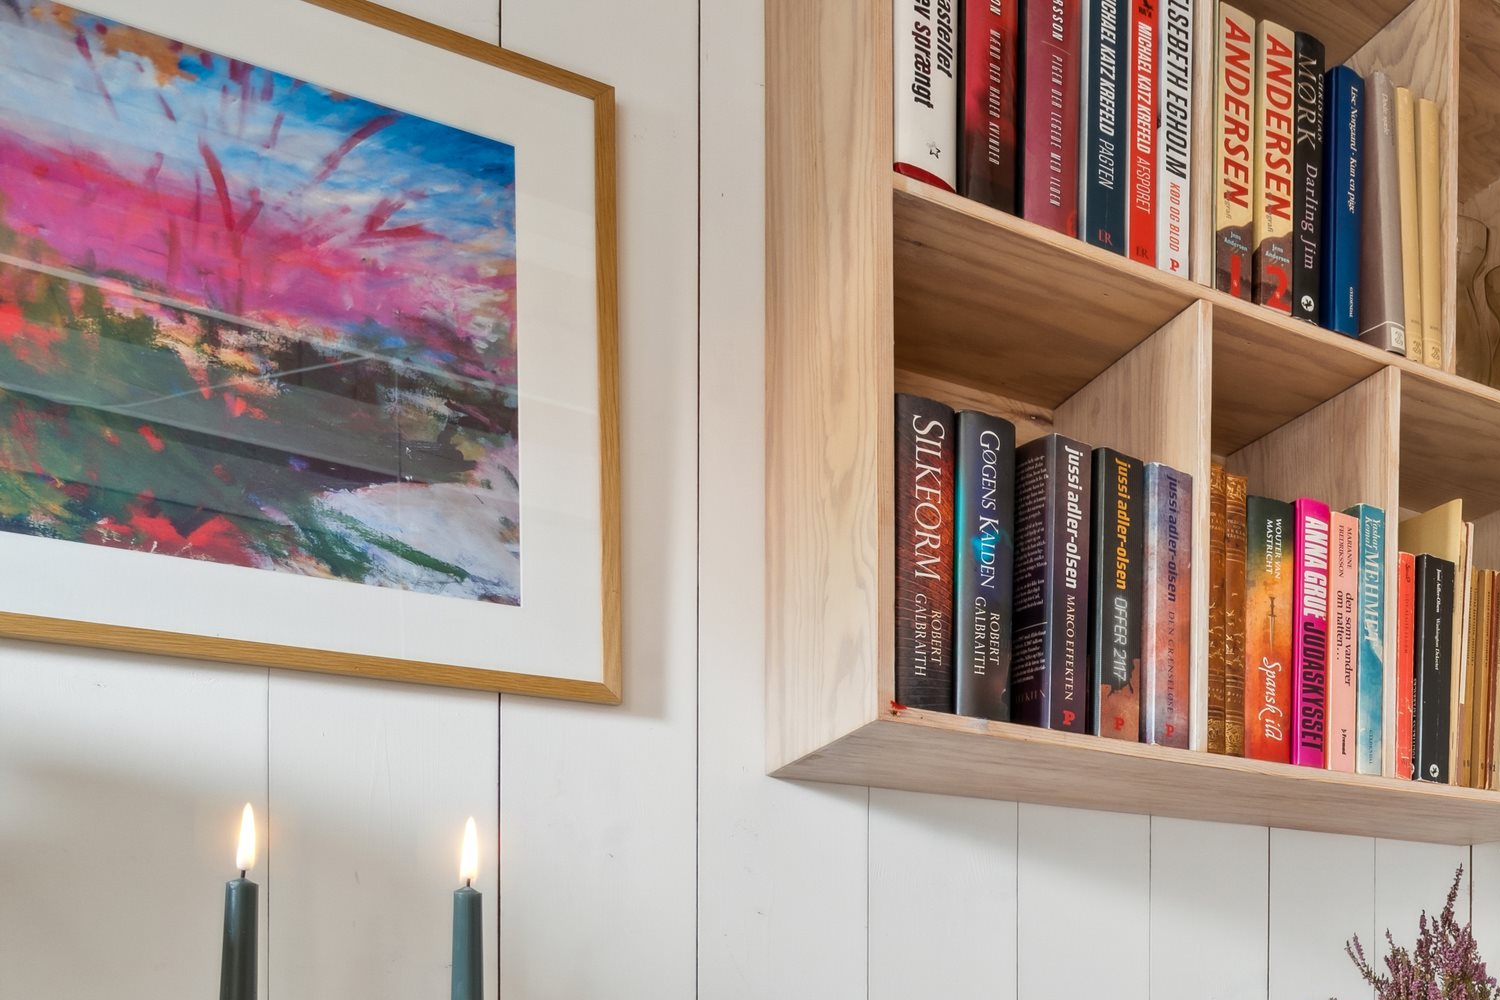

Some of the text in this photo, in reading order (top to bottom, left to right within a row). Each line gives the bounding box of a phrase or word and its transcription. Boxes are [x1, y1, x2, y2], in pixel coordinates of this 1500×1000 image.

[1049, 54, 1063, 207] PIGEN DER LEGEDE MED ILDEN
[1098, 43, 1116, 190] KATZ KREFELD PAGTEN
[1135, 21, 1152, 214] MICHAEL KATZ KREFELD AFSPORET
[1224, 16, 1251, 209] ANDERSEN
[1265, 33, 1293, 221] ANDERSEN
[1296, 52, 1318, 152] MØRK
[1169, 182, 1181, 253] KØD OG BLOD
[1224, 236, 1248, 252] Andersen
[1265, 250, 1290, 264] Andersen
[1300, 163, 1319, 270] Darling Jim
[1266, 264, 1291, 312] 2
[912, 414, 945, 581] SILKEORM
[979, 430, 1001, 589] GØGENS KALDEN
[1166, 474, 1181, 603] jussi adler-olsen
[1365, 515, 1373, 548] Kemal
[1064, 445, 1084, 701] jussi adler-olsen MARCO EFFEKTEN
[1112, 457, 1131, 682] jussi adler-olsen OFFER 2117
[1345, 592, 1354, 612] den
[1364, 549, 1380, 642] MEHMET
[914, 593, 927, 677] GALBRAITH
[931, 609, 942, 665] ROBERT
[974, 596, 986, 676] GALBRAITH
[989, 611, 1000, 665] ROBERT
[1300, 516, 1329, 753] ANNA GRUE JUDASKYSSET
[1344, 640, 1353, 686] vandrer
